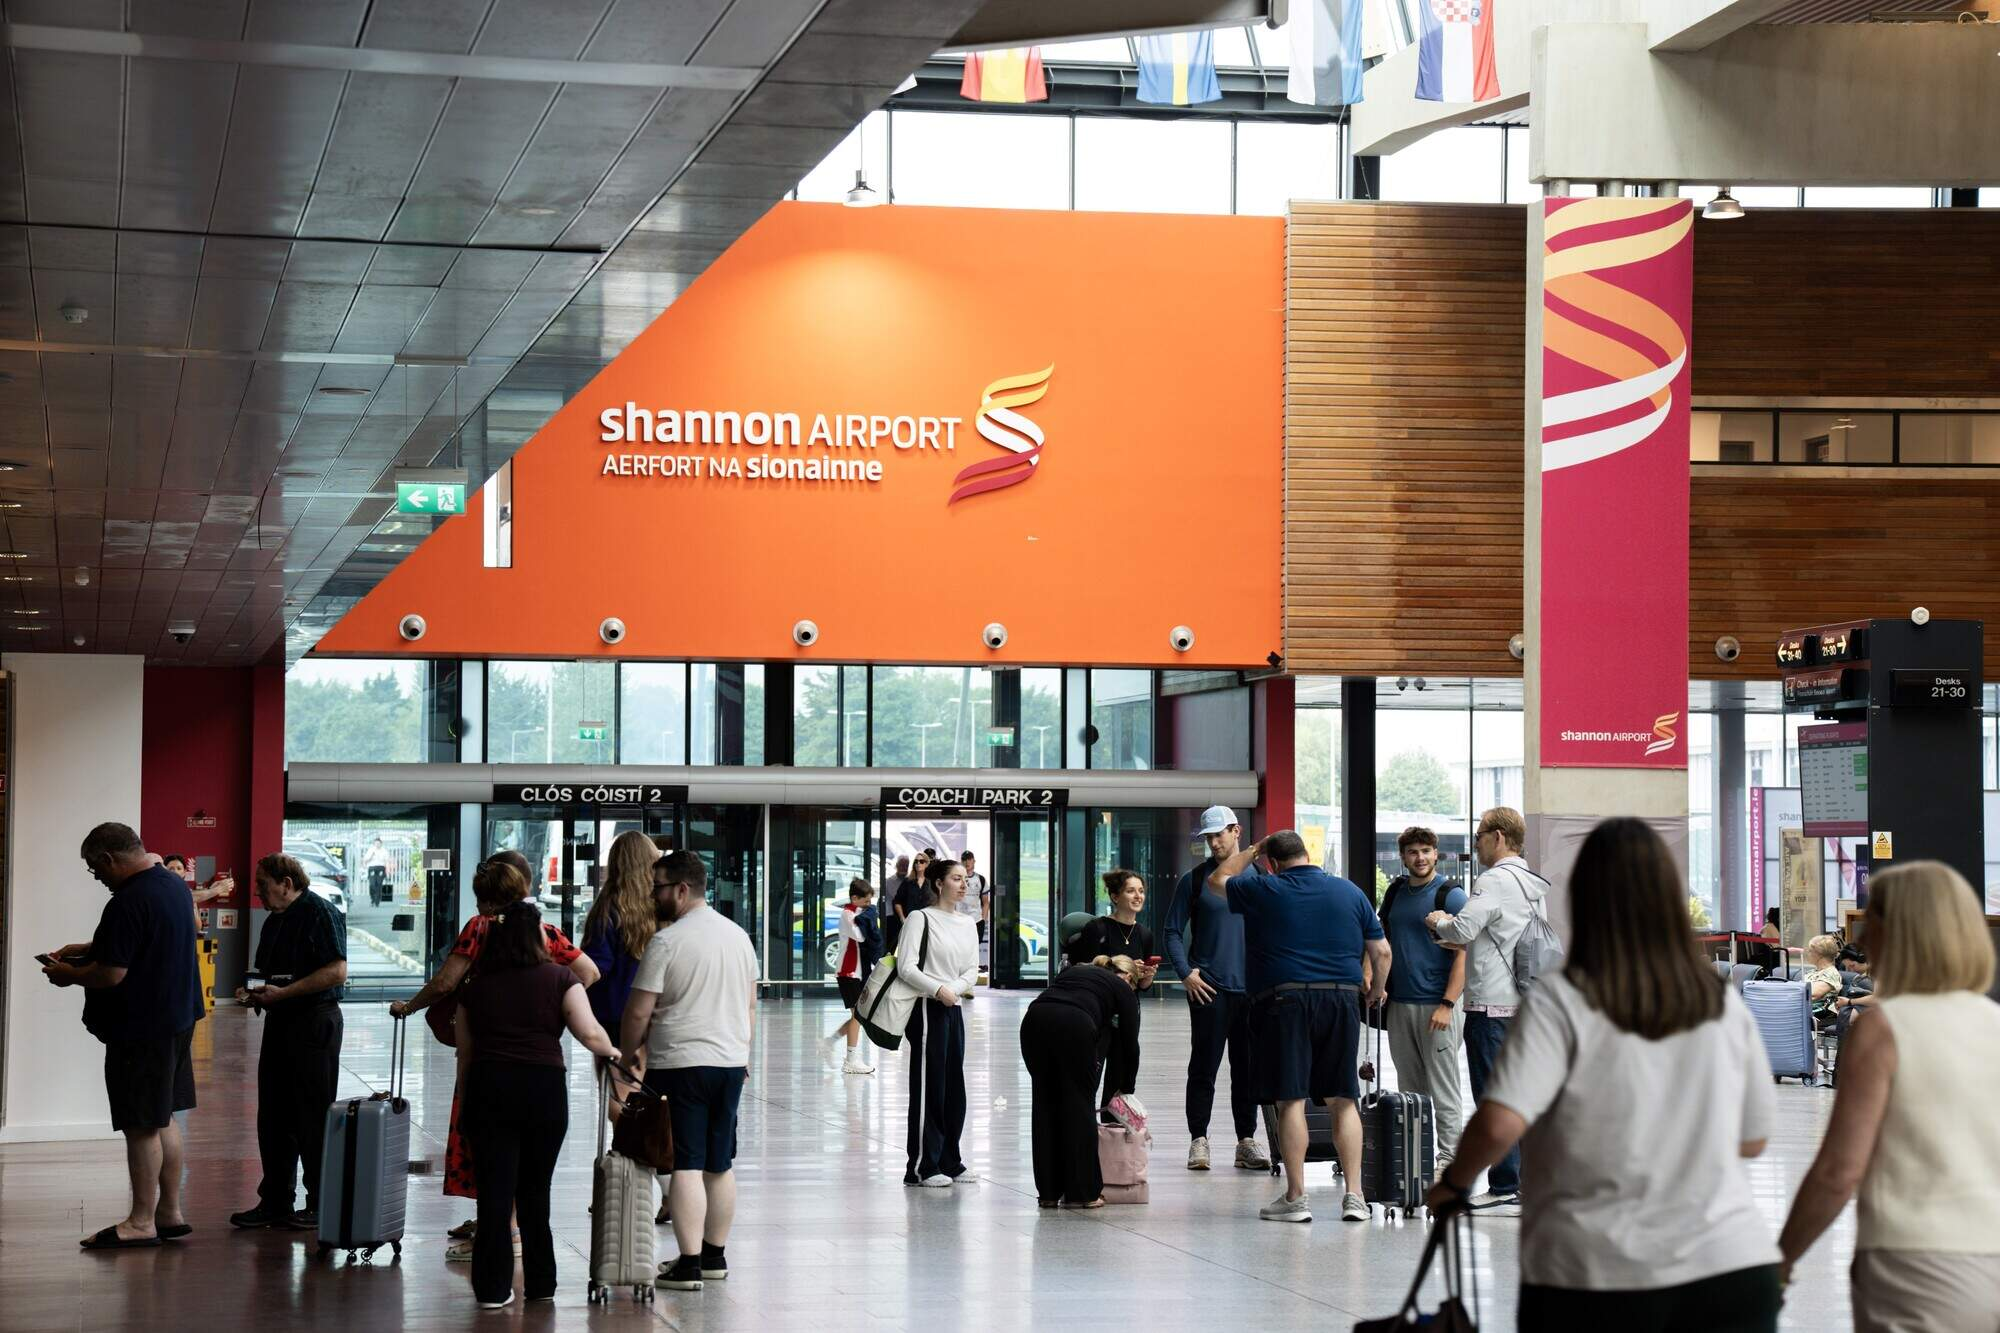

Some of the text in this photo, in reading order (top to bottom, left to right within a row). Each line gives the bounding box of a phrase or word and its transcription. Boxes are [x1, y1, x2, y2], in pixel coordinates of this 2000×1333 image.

[601, 401, 961, 449] shannon AIRPORT
[602, 454, 883, 481] AERFORT NA sionainne
[1822, 645, 1837, 657] 21-30
[1935, 677, 1961, 685] Desks
[1931, 687, 1966, 698] 21-30
[1561, 730, 1652, 742] shannon AIRPORT
[521, 784, 661, 802] CLÓS CÓISTÍ 2
[899, 788, 1053, 804] COACH PARK 2
[1751, 788, 1761, 923] shannonairport.ie
